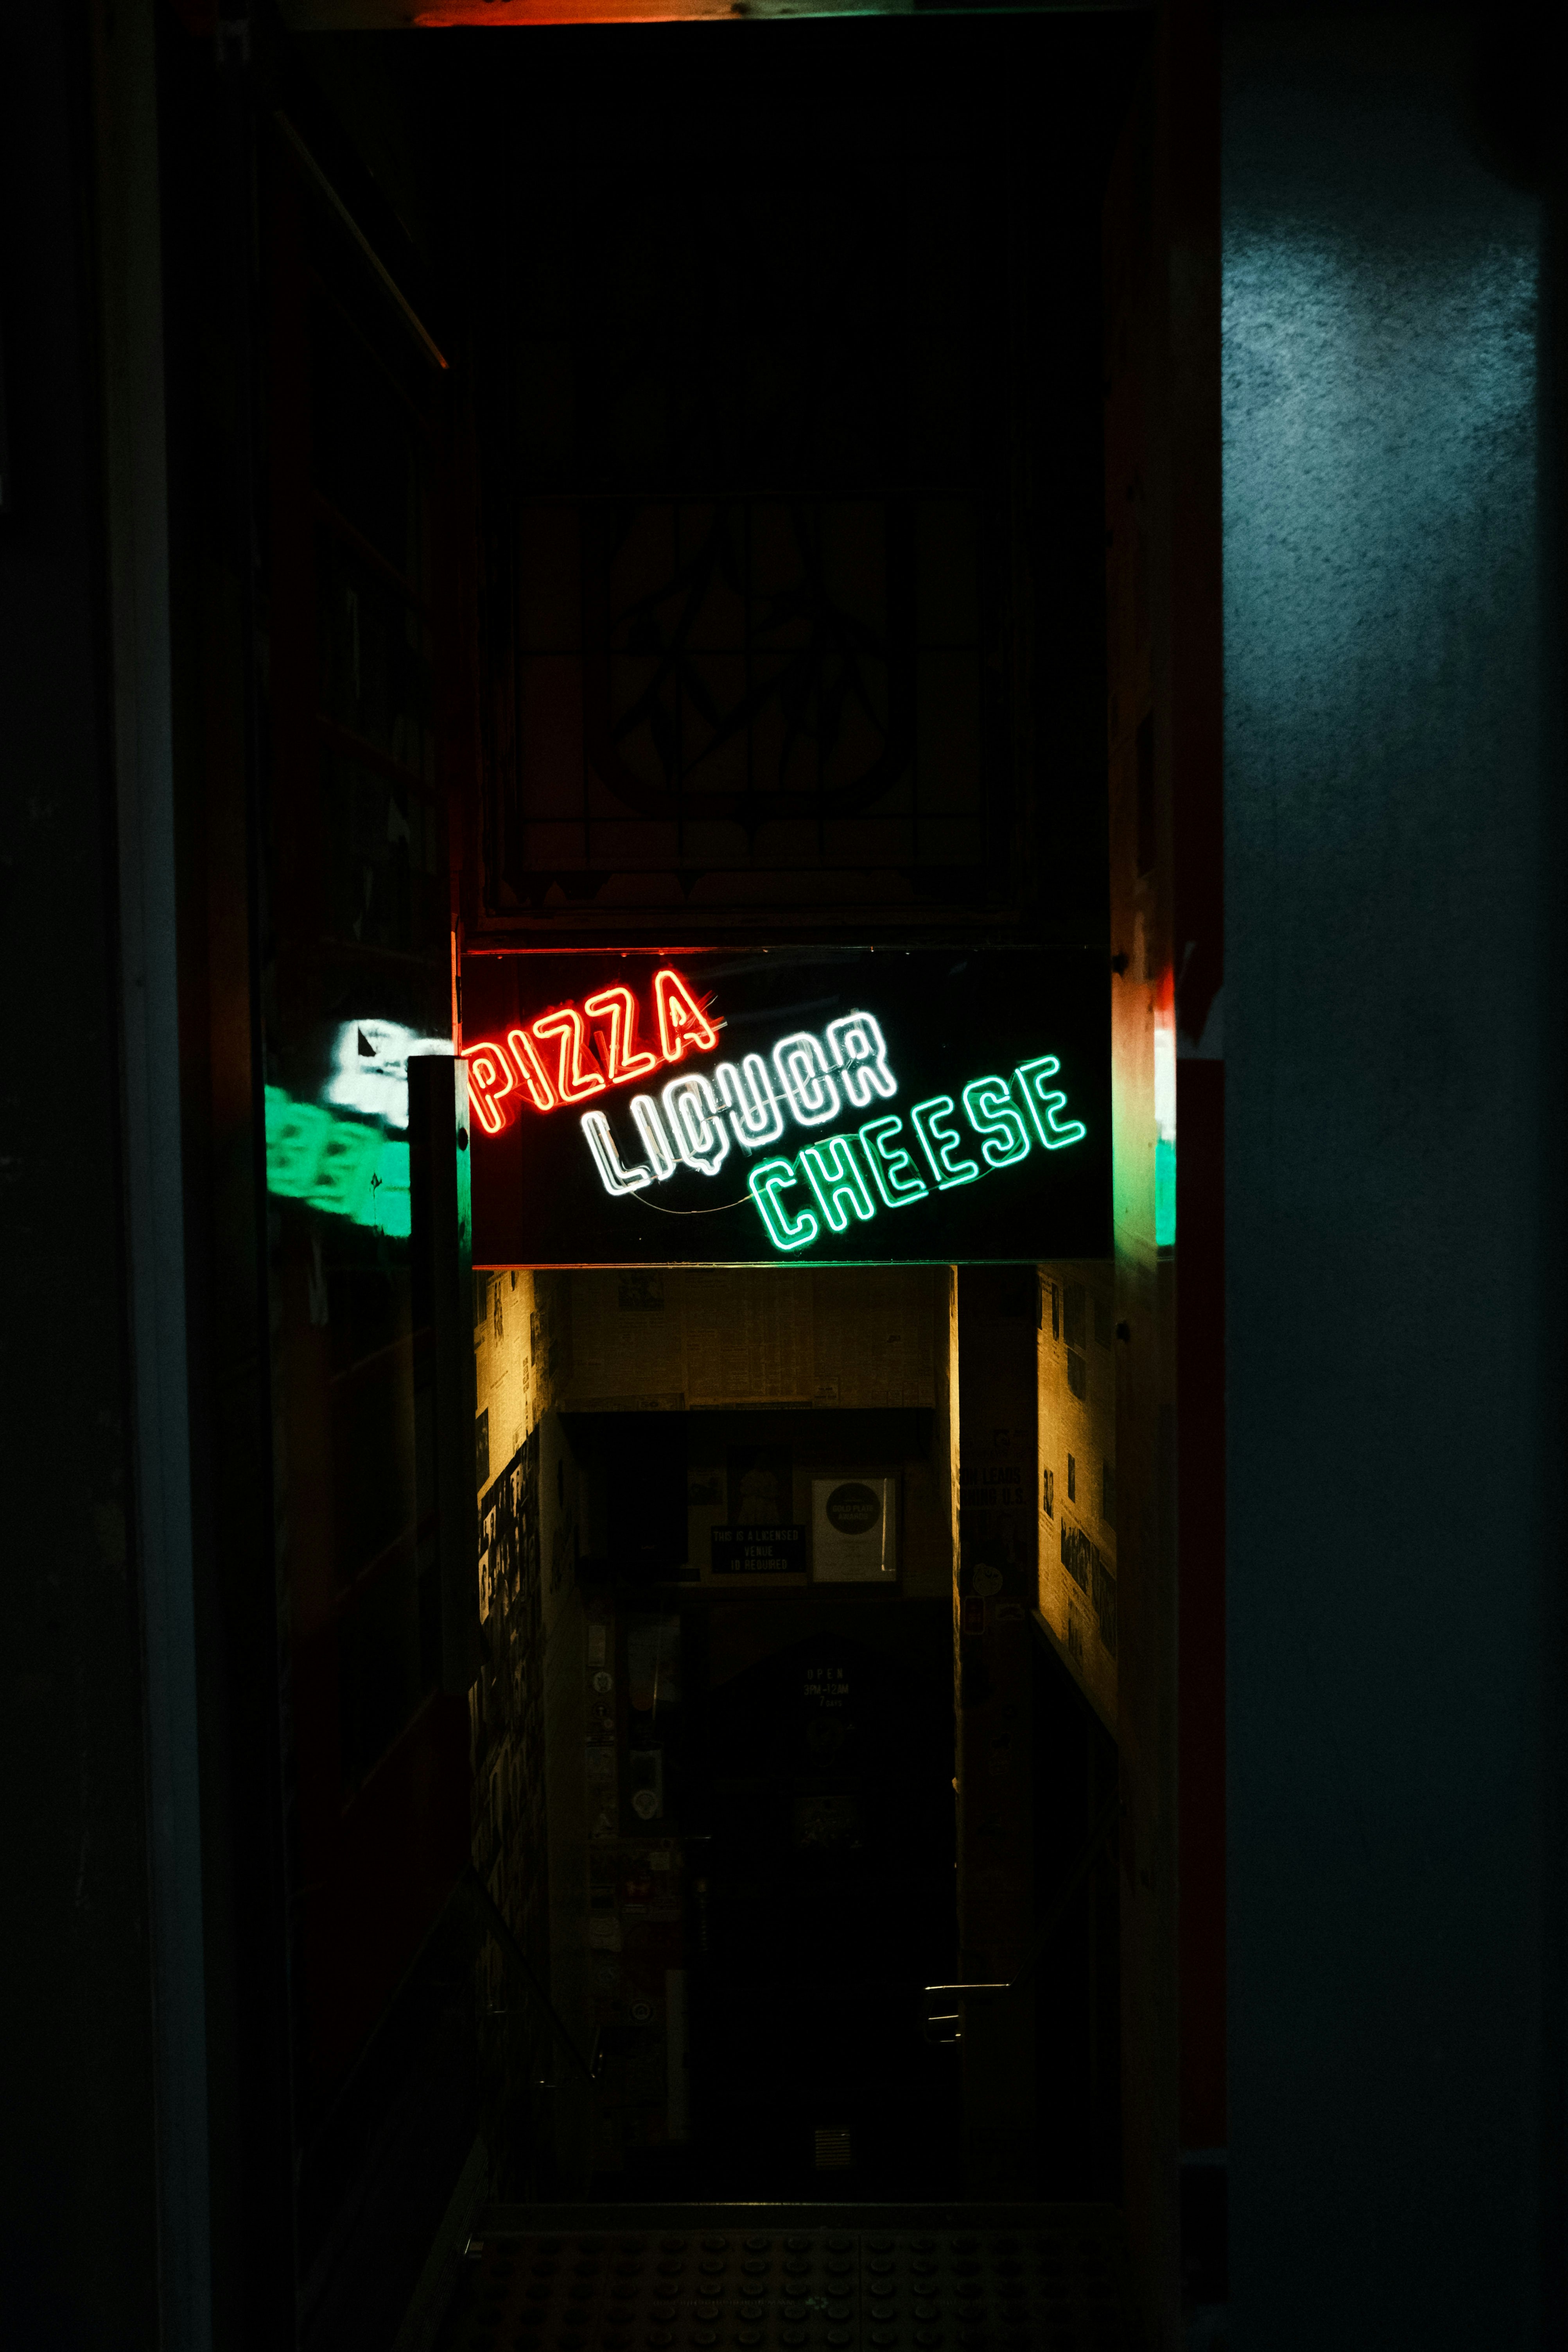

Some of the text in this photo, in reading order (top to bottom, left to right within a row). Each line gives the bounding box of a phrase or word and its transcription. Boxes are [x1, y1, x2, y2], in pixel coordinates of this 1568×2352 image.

[461, 969, 719, 1136] PIZZA
[581, 1011, 899, 1197] LIQUOR
[748, 1055, 1087, 1251] CHEESE
[983, 1467, 1021, 1485] LEADS
[1002, 1487, 1027, 1505] U.S.
[713, 1529, 799, 1542] THIS IS A LICENSED
[744, 1545, 774, 1557] VENUE
[730, 1559, 788, 1570] ID REQUIRED
[807, 1667, 843, 1680] OPEN
[804, 1683, 849, 1695] 3PM-12AM
[819, 1695, 825, 1707] 7
